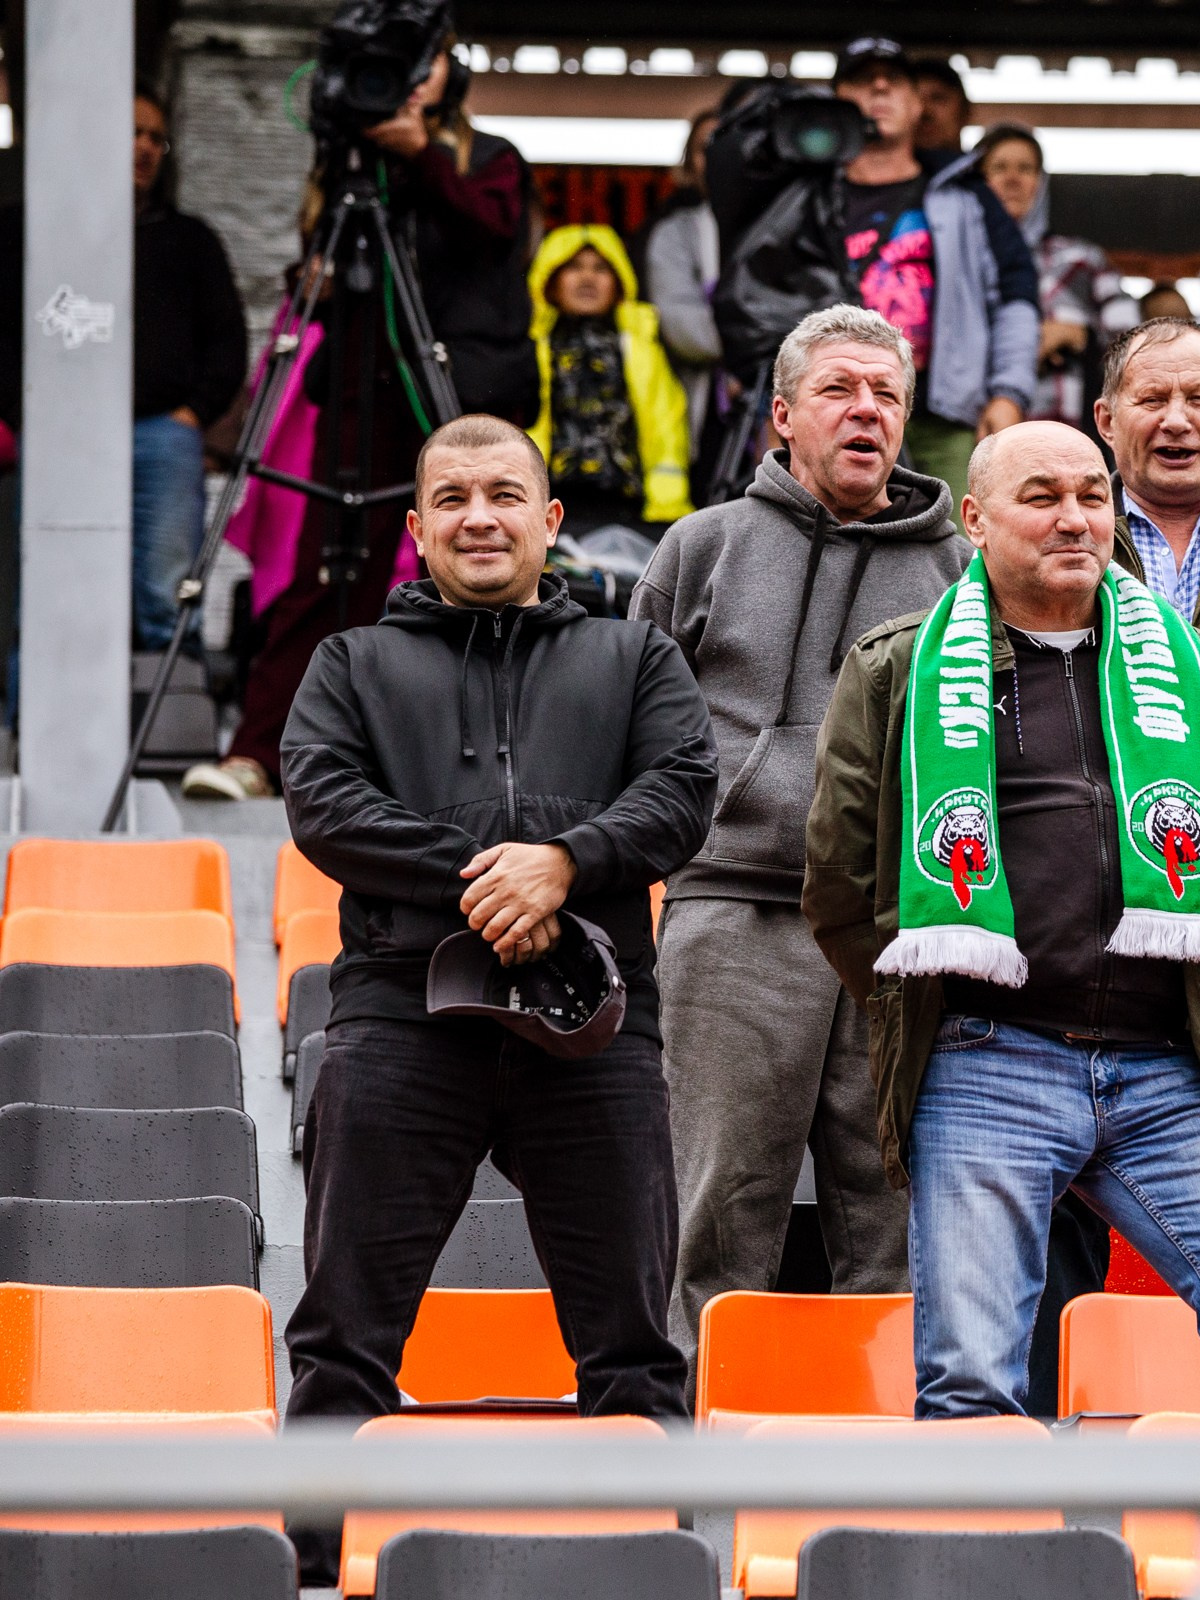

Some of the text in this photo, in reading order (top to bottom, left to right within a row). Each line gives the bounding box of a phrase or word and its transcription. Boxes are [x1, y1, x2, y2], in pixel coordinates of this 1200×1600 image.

[935, 793, 989, 818] ИРКУТС
[1132, 821, 1144, 833] 20
[919, 840, 932, 852] 20
